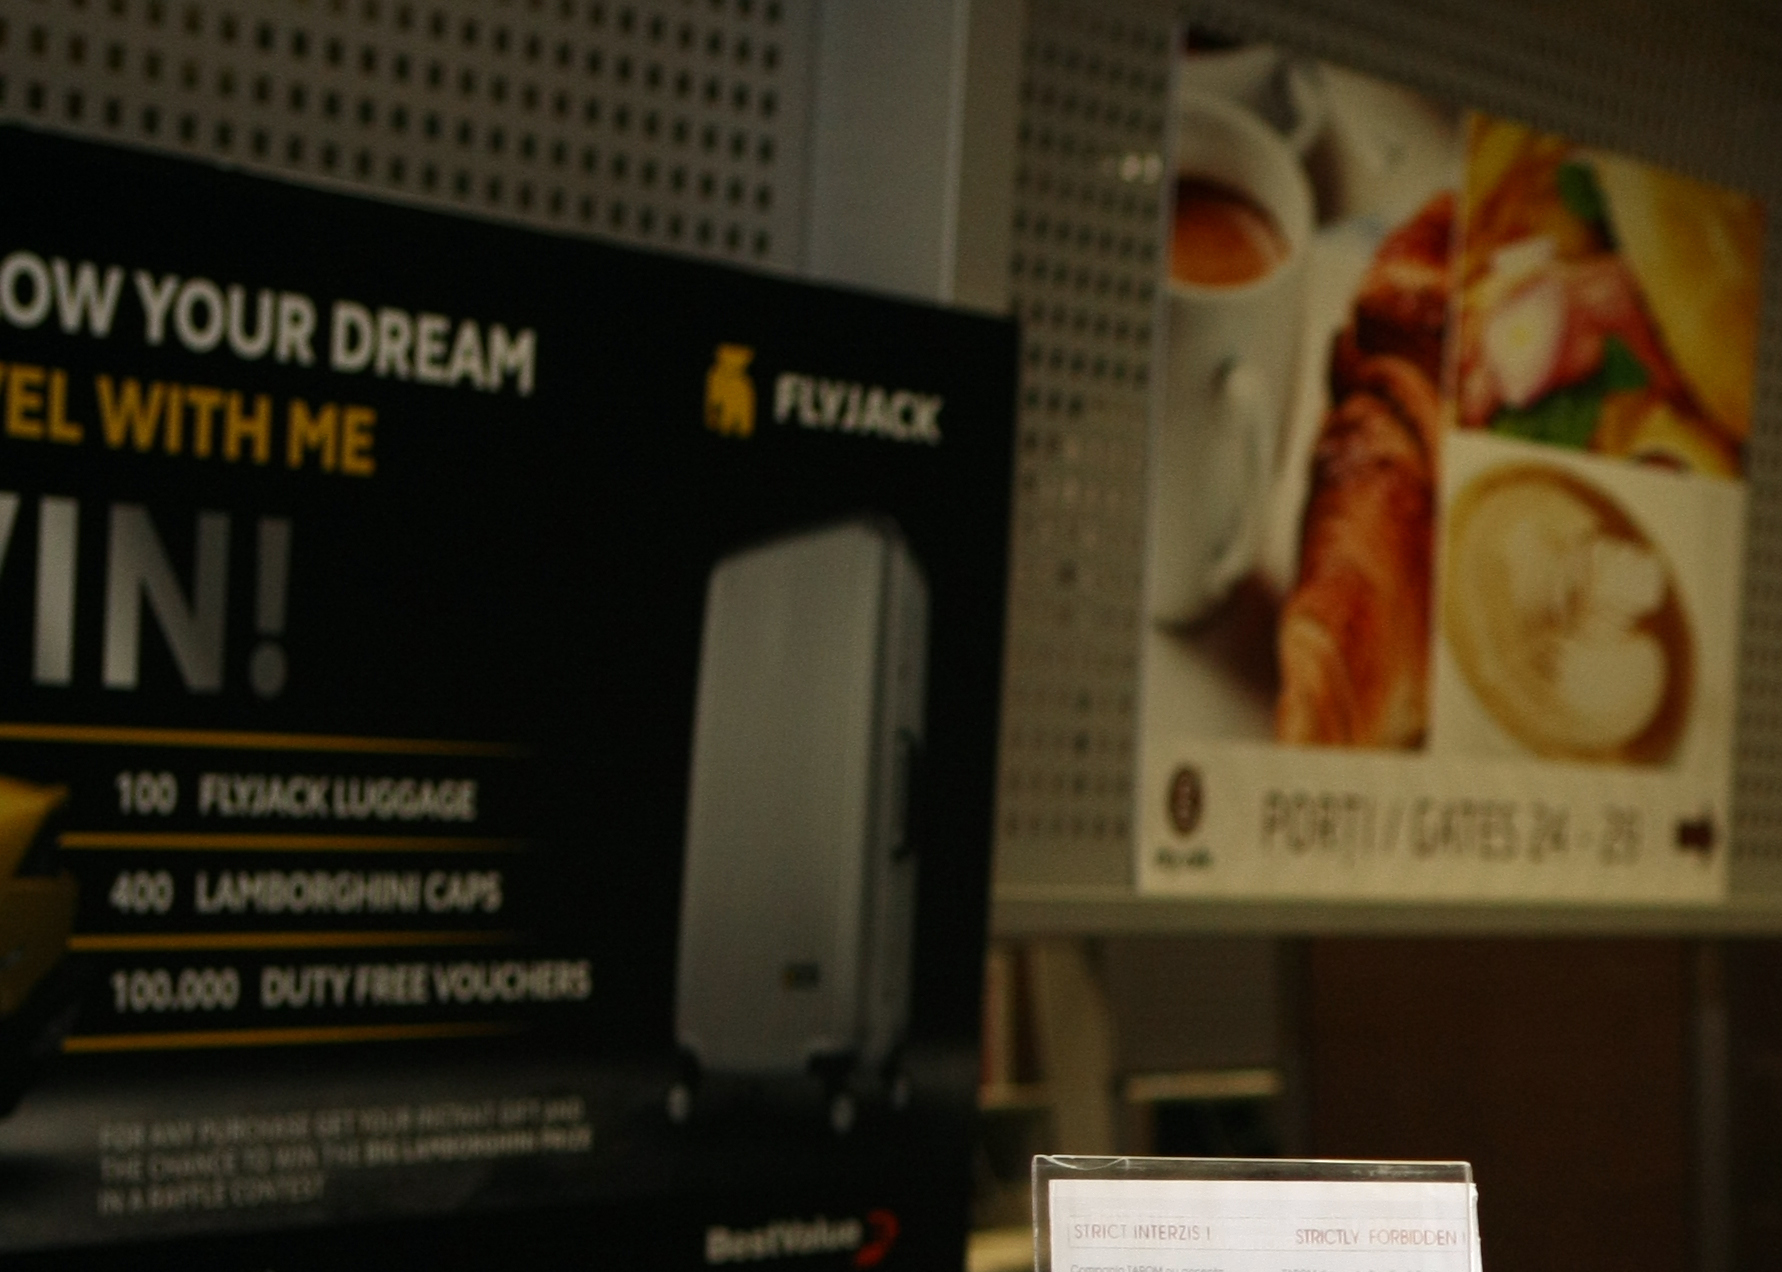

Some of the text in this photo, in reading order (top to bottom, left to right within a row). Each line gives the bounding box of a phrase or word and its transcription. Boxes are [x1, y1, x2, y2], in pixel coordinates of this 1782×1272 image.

[134, 268, 317, 368] YOUR
[331, 299, 536, 398] DREAM
[0, 362, 377, 476] EL WITH ME
[773, 370, 944, 446] FLYJACK
[0, 491, 292, 699] IN!
[116, 771, 478, 822] 100 FLYJACK LUGGAGE
[1412, 795, 1520, 862] GATES
[110, 871, 503, 914] 400 LAMBORGHINI CAPS
[111, 960, 592, 1012] 100.000 DUTY FREE VOUCHERS
[100, 1120, 145, 1149] FOR
[1074, 1223, 1127, 1240] STRICT
[1133, 1225, 1201, 1241] INTERZIS
[1296, 1229, 1359, 1245] STRICTLY
[1369, 1229, 1457, 1246] FORBIDDEN
